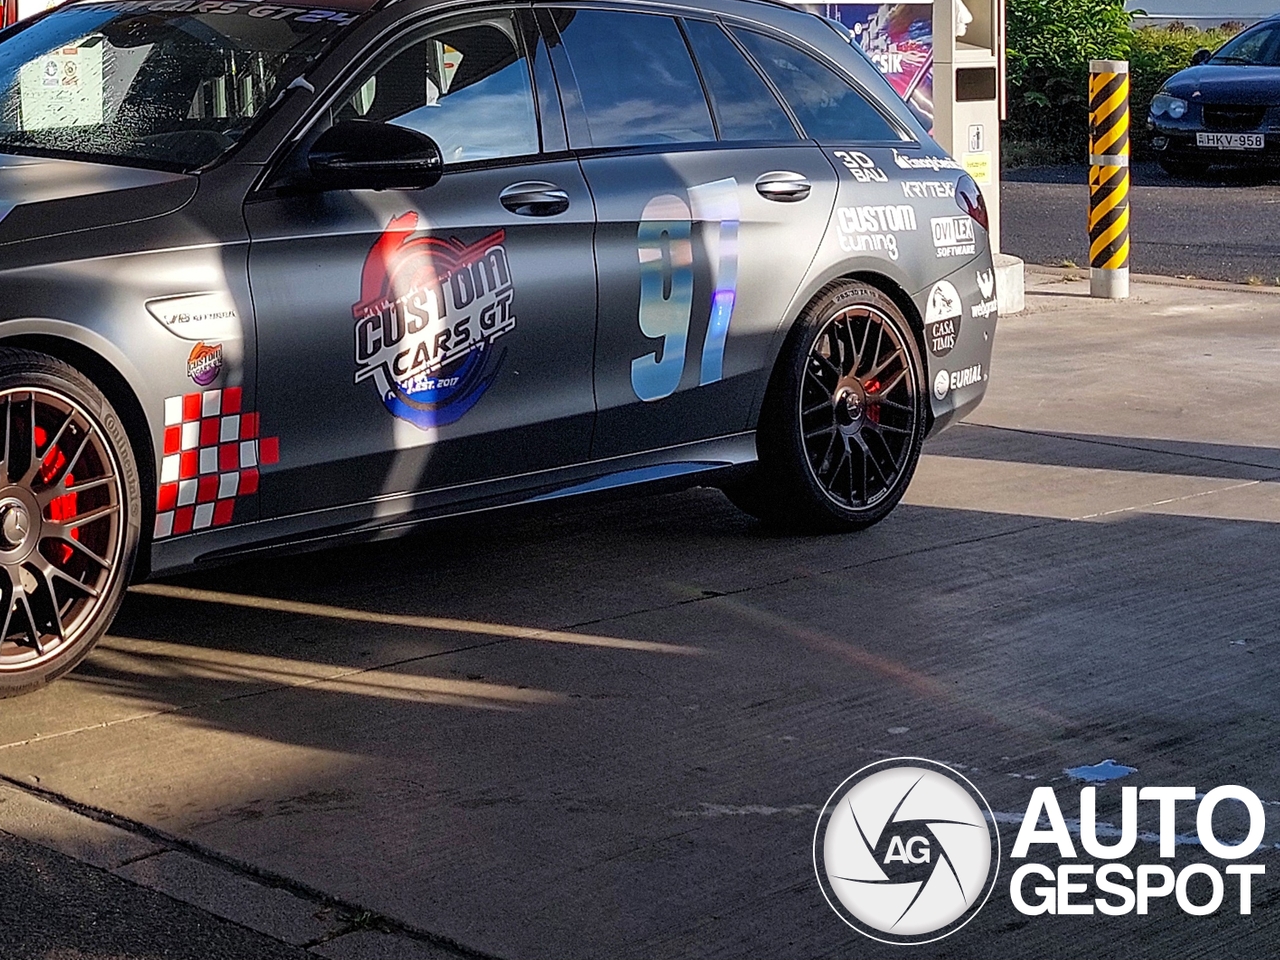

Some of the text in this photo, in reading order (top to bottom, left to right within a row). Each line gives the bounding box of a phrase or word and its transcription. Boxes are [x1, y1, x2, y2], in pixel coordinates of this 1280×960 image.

[1206, 134, 1262, 147] HKV-958
[834, 151, 875, 168] 3D
[849, 167, 889, 182] BAU
[837, 204, 918, 234] CUSTOM
[836, 225, 900, 261] tuning
[935, 245, 977, 258] SOFTWARE
[630, 177, 740, 402] 97
[356, 248, 511, 362] CUSTOM
[392, 292, 513, 378] CARS GT
[932, 319, 956, 339] CASA
[437, 377, 460, 388] 2017
[950, 362, 982, 390] EURIAL
[104, 413, 138, 503] Continental
